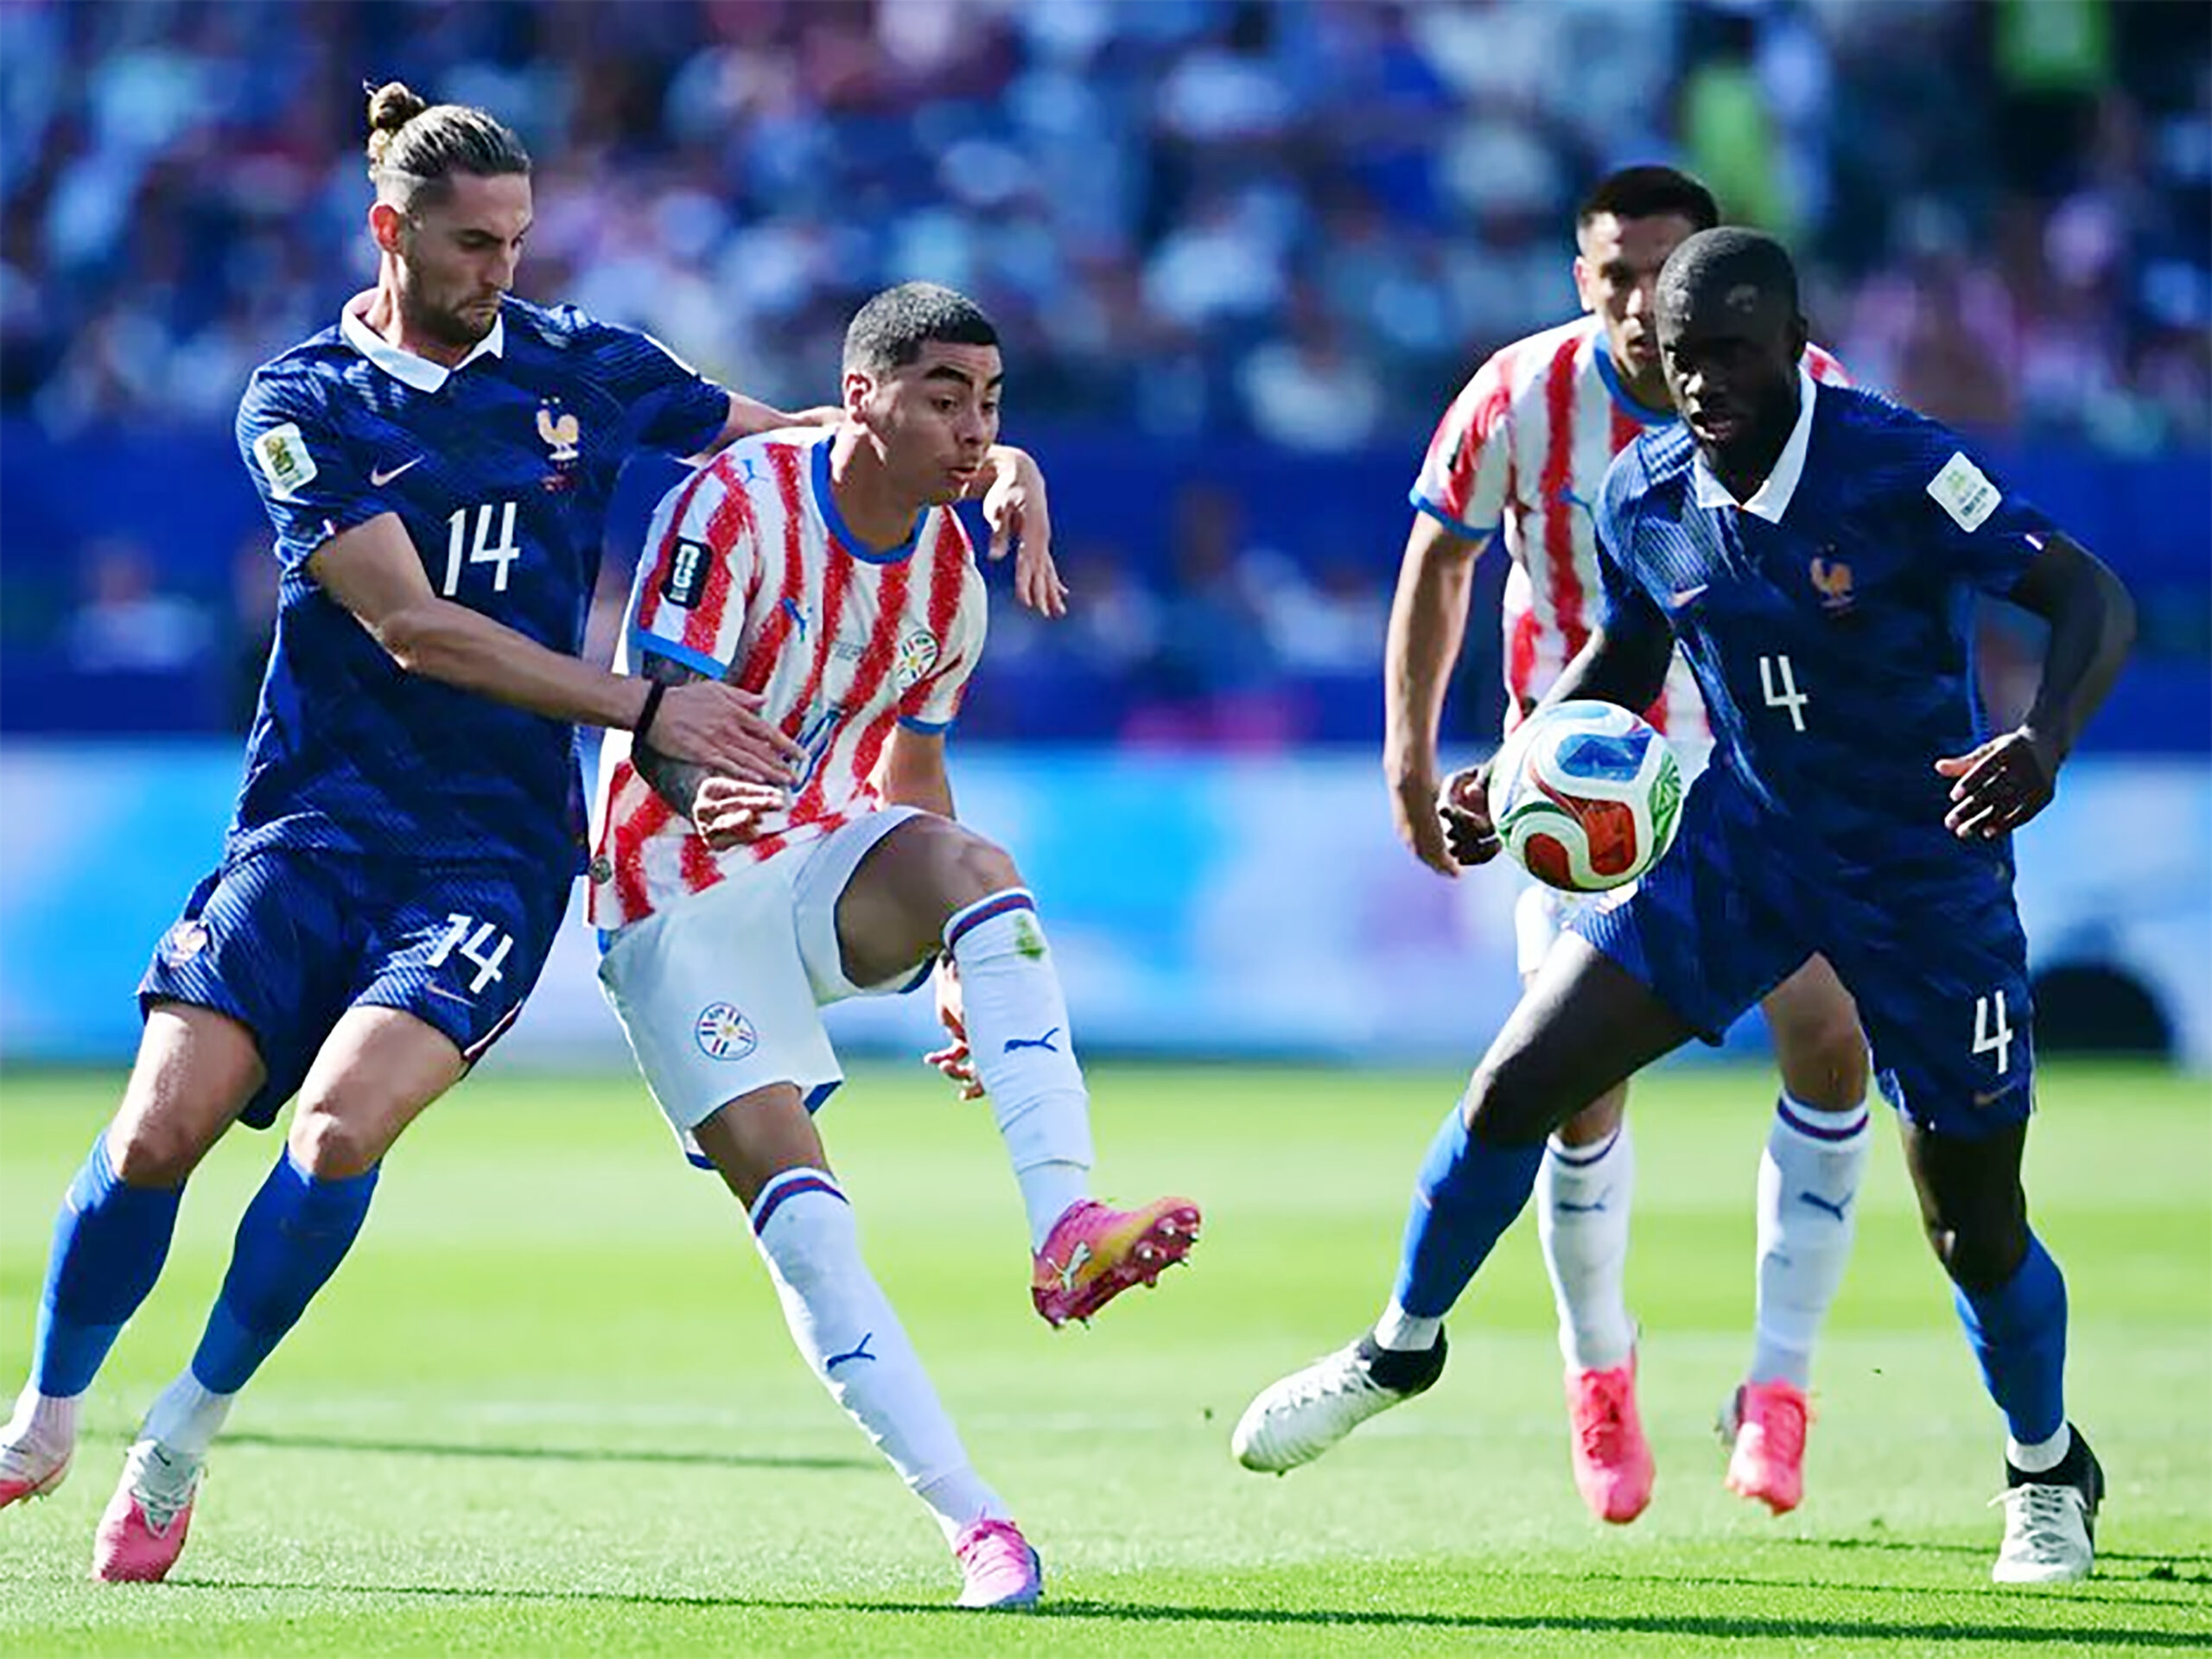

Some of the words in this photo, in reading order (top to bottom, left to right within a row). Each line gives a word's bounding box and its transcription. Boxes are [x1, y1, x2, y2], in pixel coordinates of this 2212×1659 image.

[443, 501, 520, 596] 14
[1759, 655, 1808, 732] 4
[426, 912, 513, 994] 14
[1972, 989, 2013, 1074] 4
